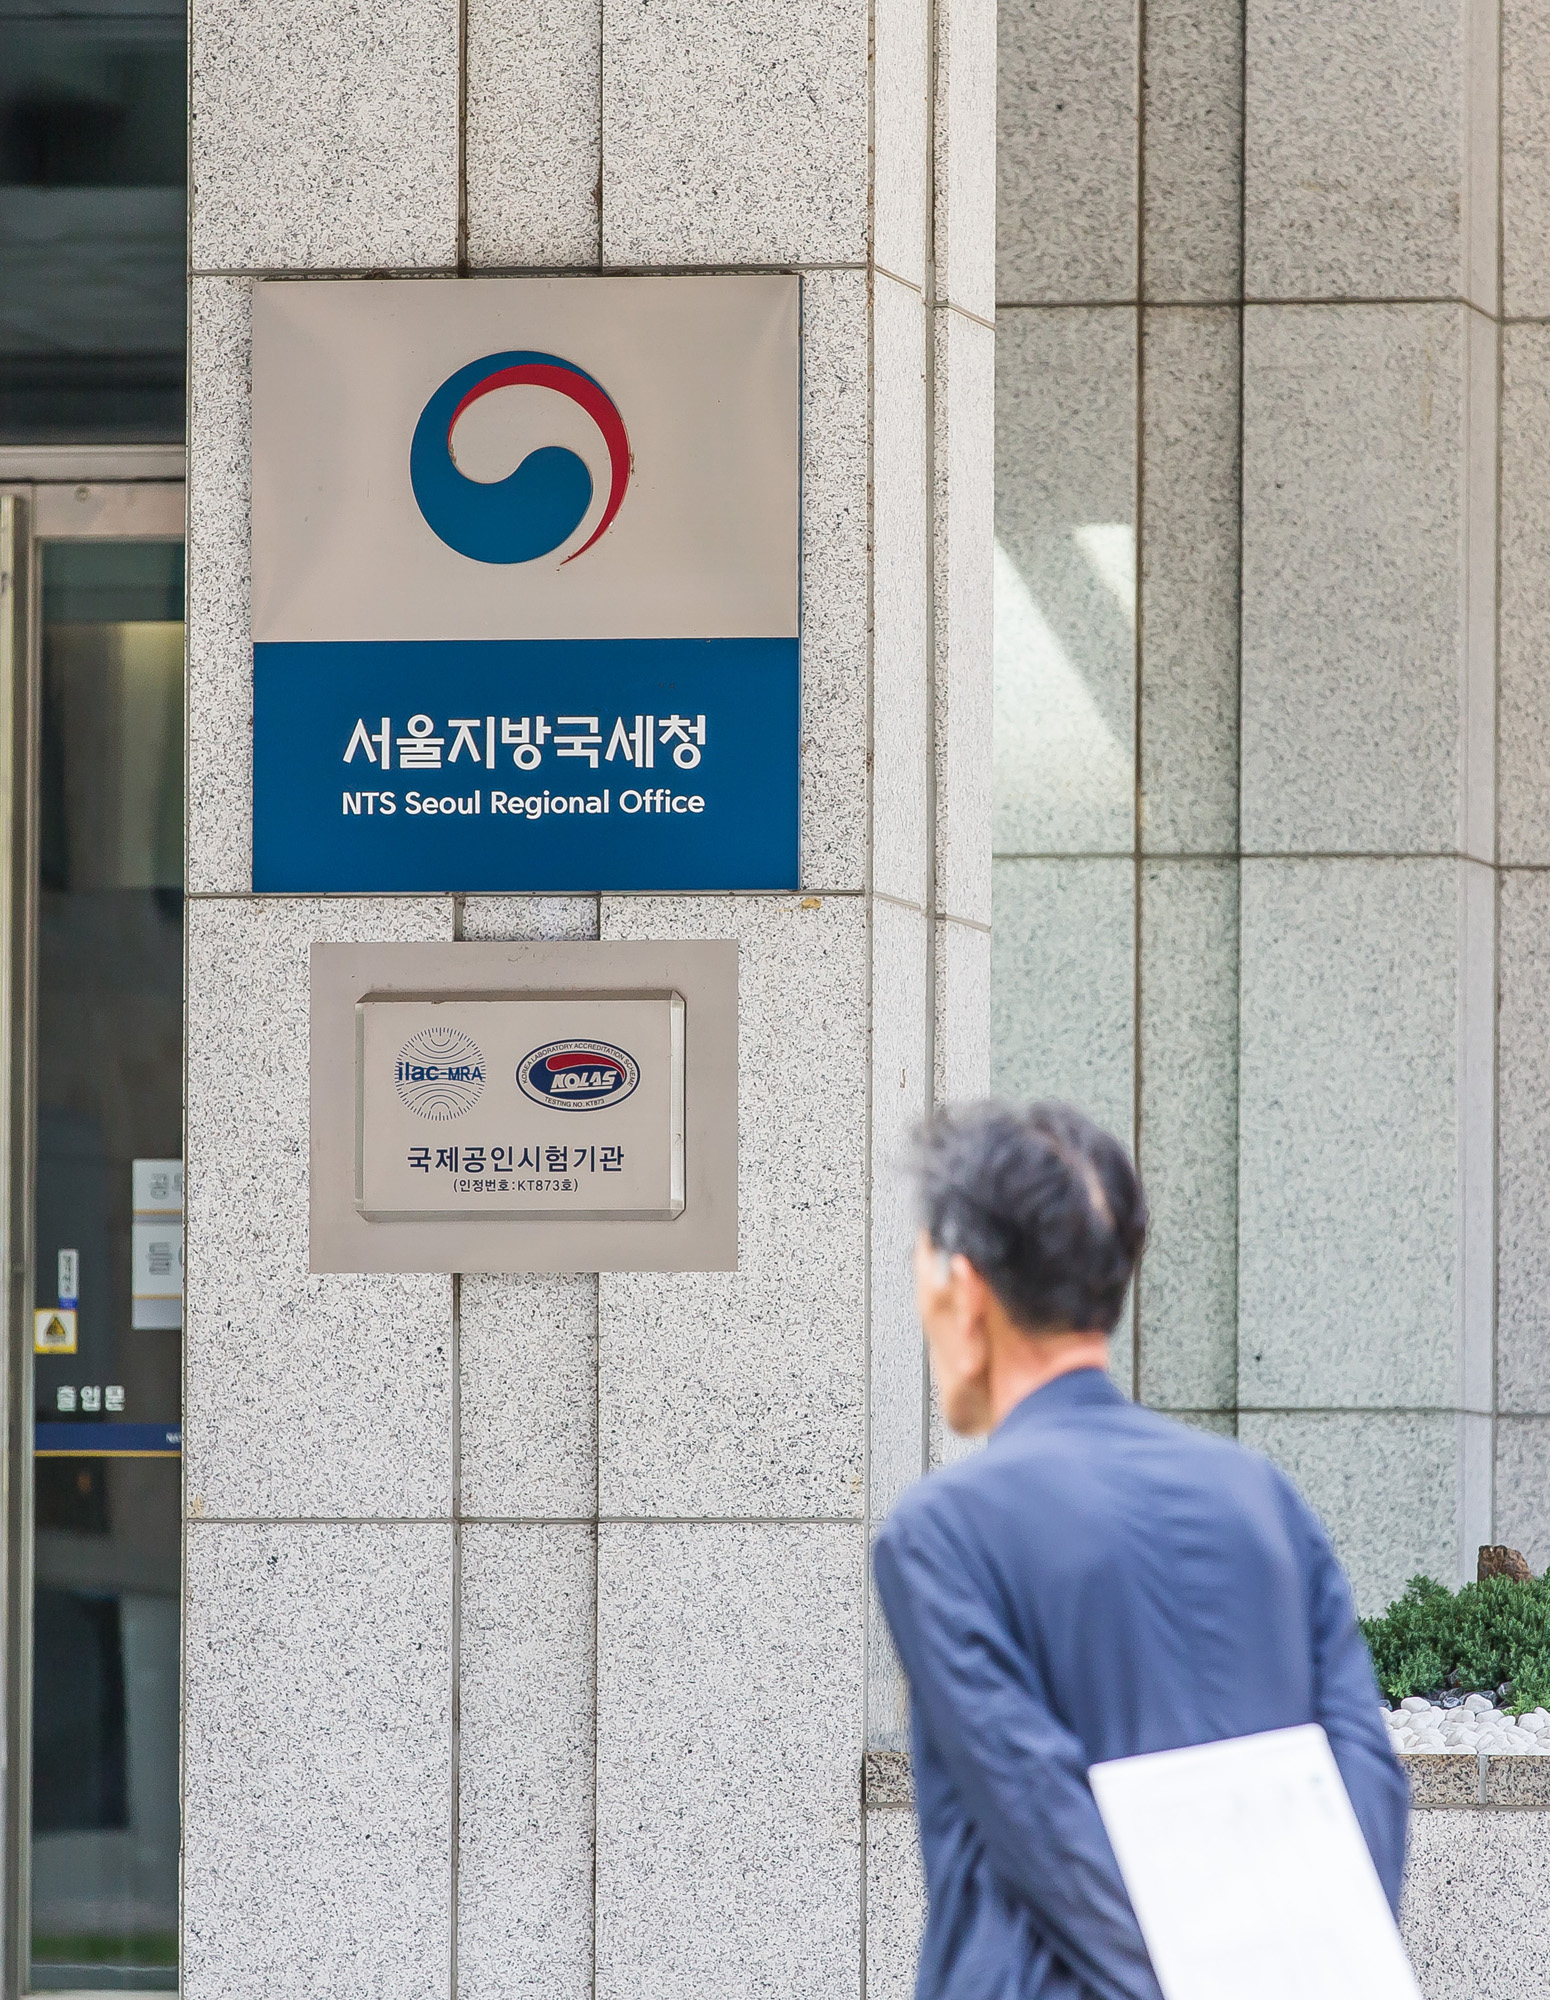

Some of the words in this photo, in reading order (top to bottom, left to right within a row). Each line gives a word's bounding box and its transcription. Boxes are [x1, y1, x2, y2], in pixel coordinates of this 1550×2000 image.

[342, 713, 706, 770] 서울지방국세청
[342, 791, 397, 815] NTS
[404, 789, 481, 815] Seoul
[490, 789, 610, 820] Regional
[619, 788, 706, 814] Office
[398, 1061, 483, 1081] ilac-MRA
[521, 1061, 532, 1085] KOREA
[530, 1043, 574, 1063] LABORATORY
[573, 1042, 625, 1061] ACCREDITATION
[623, 1058, 636, 1088] SCHEME
[550, 1070, 618, 1090] KOLAS
[544, 1096, 572, 1108] TESTING
[585, 1098, 605, 1107] KT873
[407, 1145, 625, 1174] 국제공인시험기관
[453, 1178, 579, 1193] (인정번호:KT873호)
